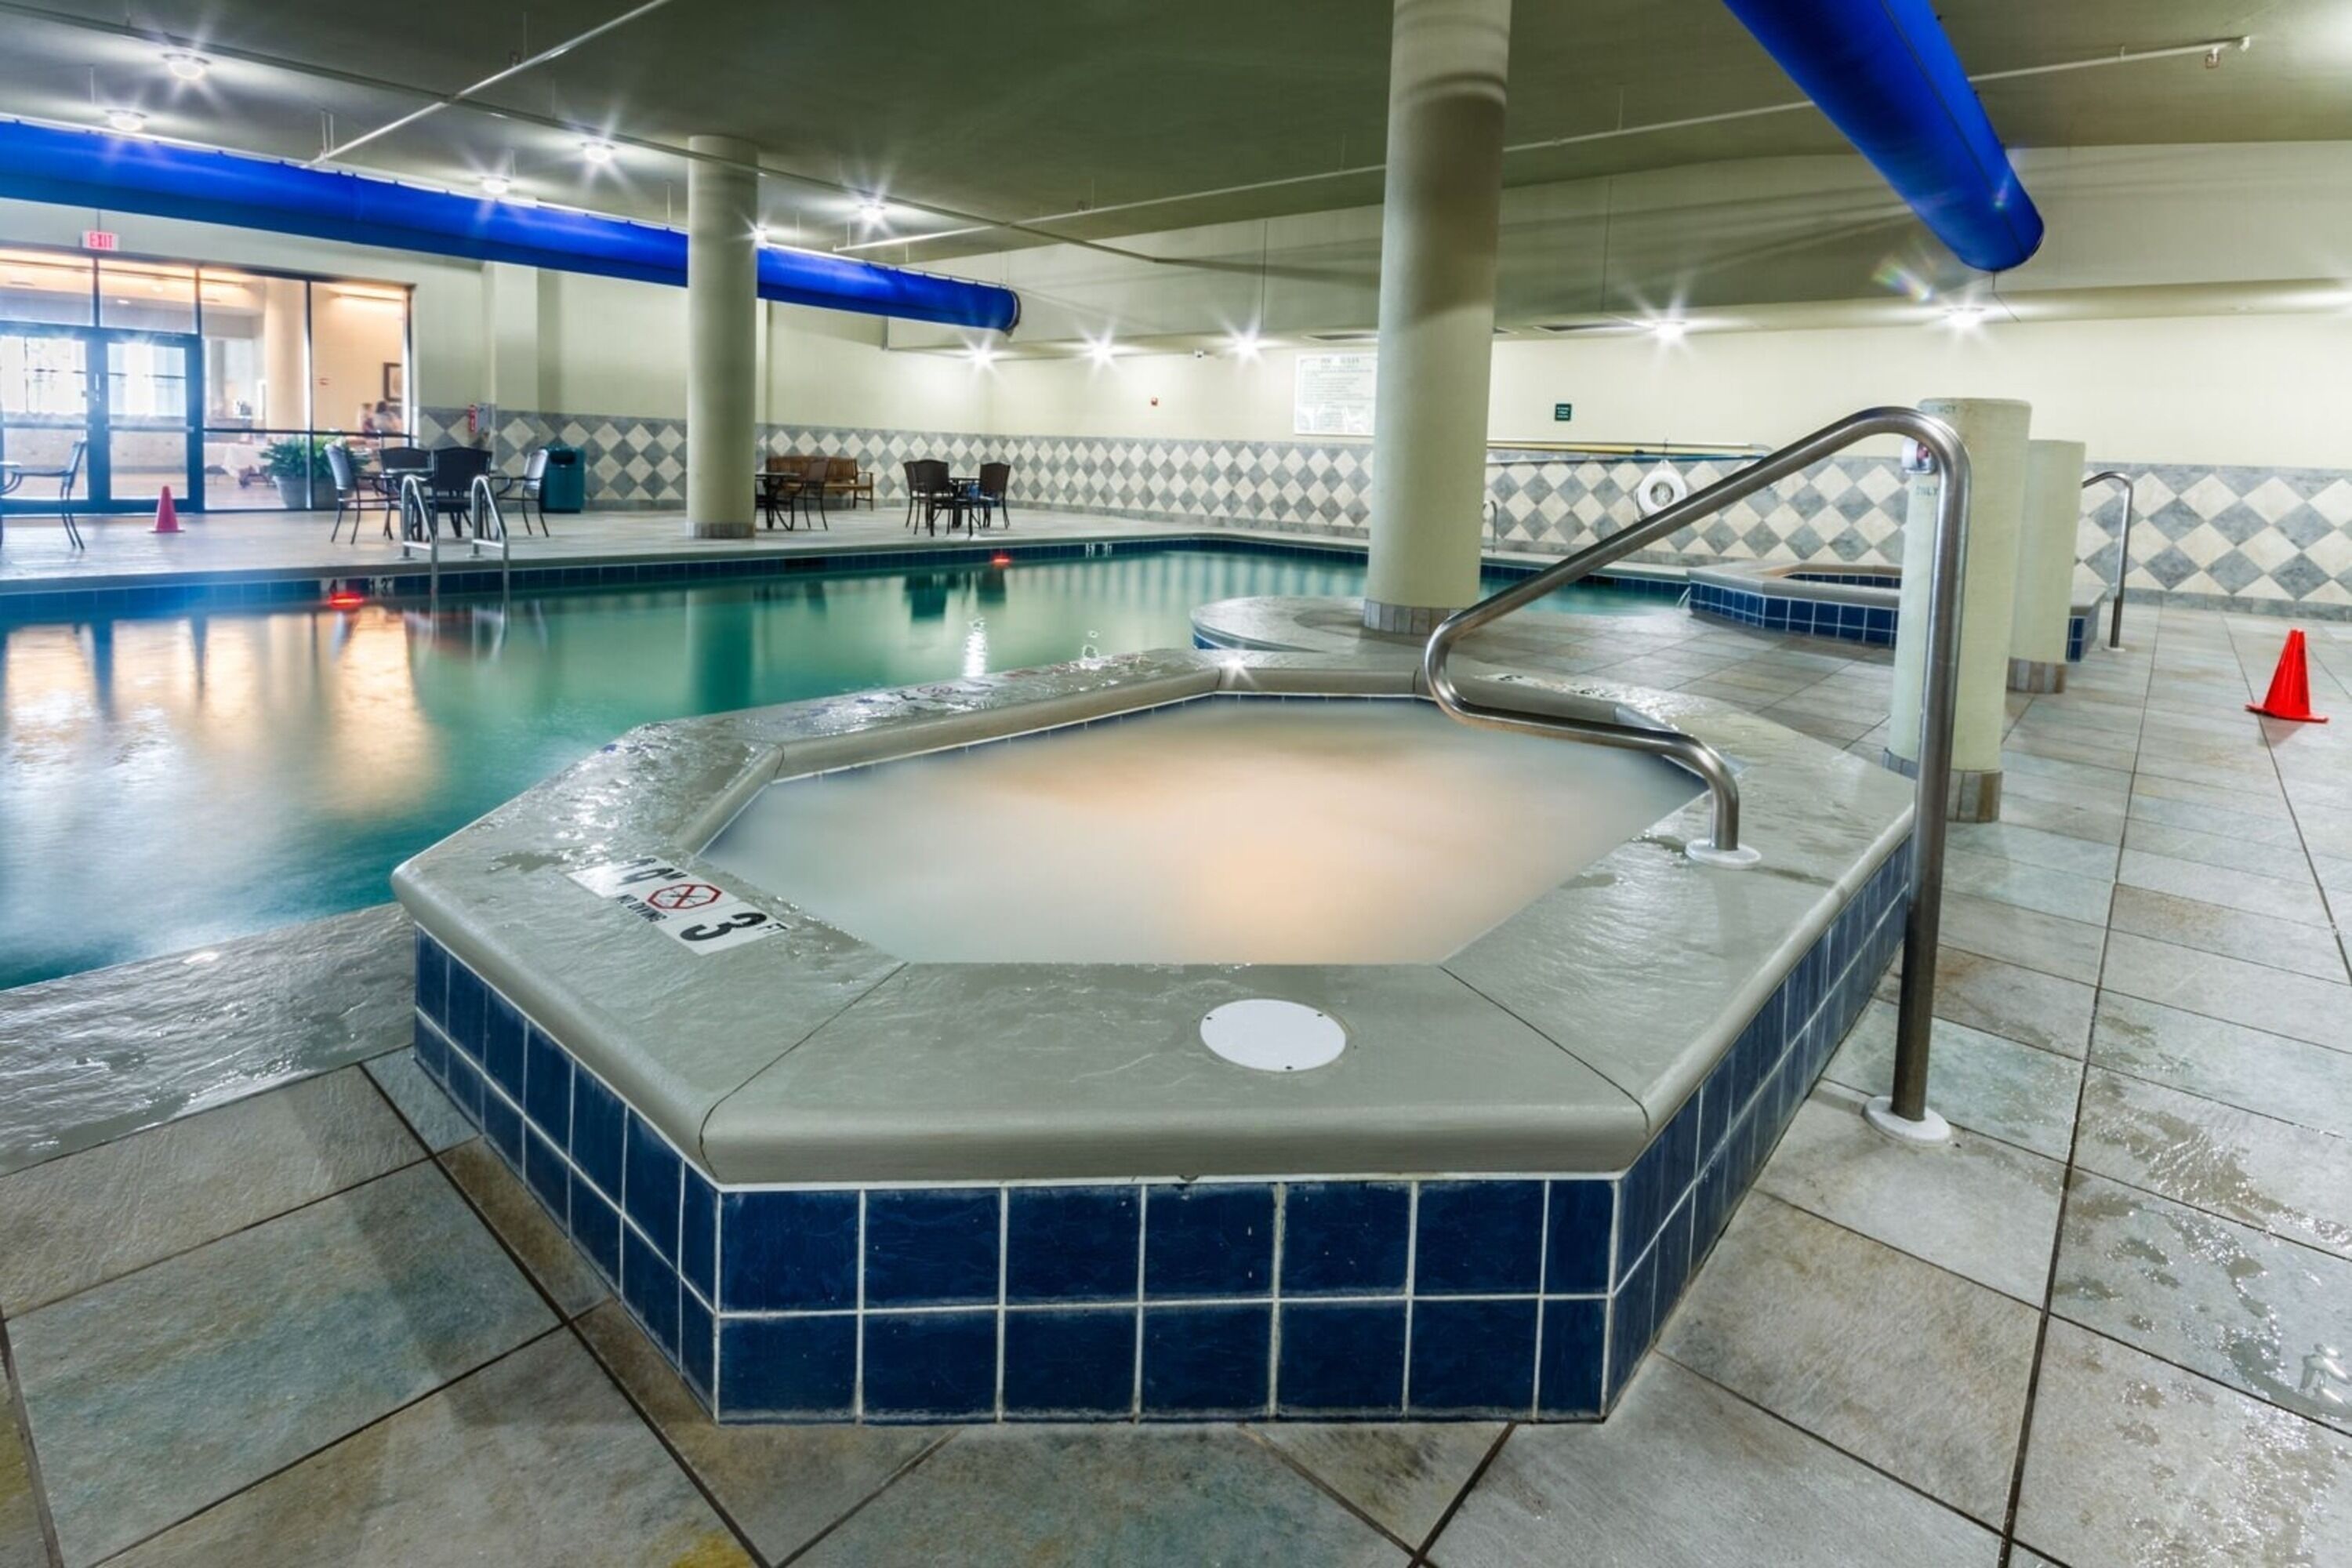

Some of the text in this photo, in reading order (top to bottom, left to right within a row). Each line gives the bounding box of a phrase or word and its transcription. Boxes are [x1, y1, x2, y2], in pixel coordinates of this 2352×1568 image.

[89, 232, 113, 249] EXIT
[615, 893, 667, 923] NO DIVING
[680, 912, 768, 941] 3
